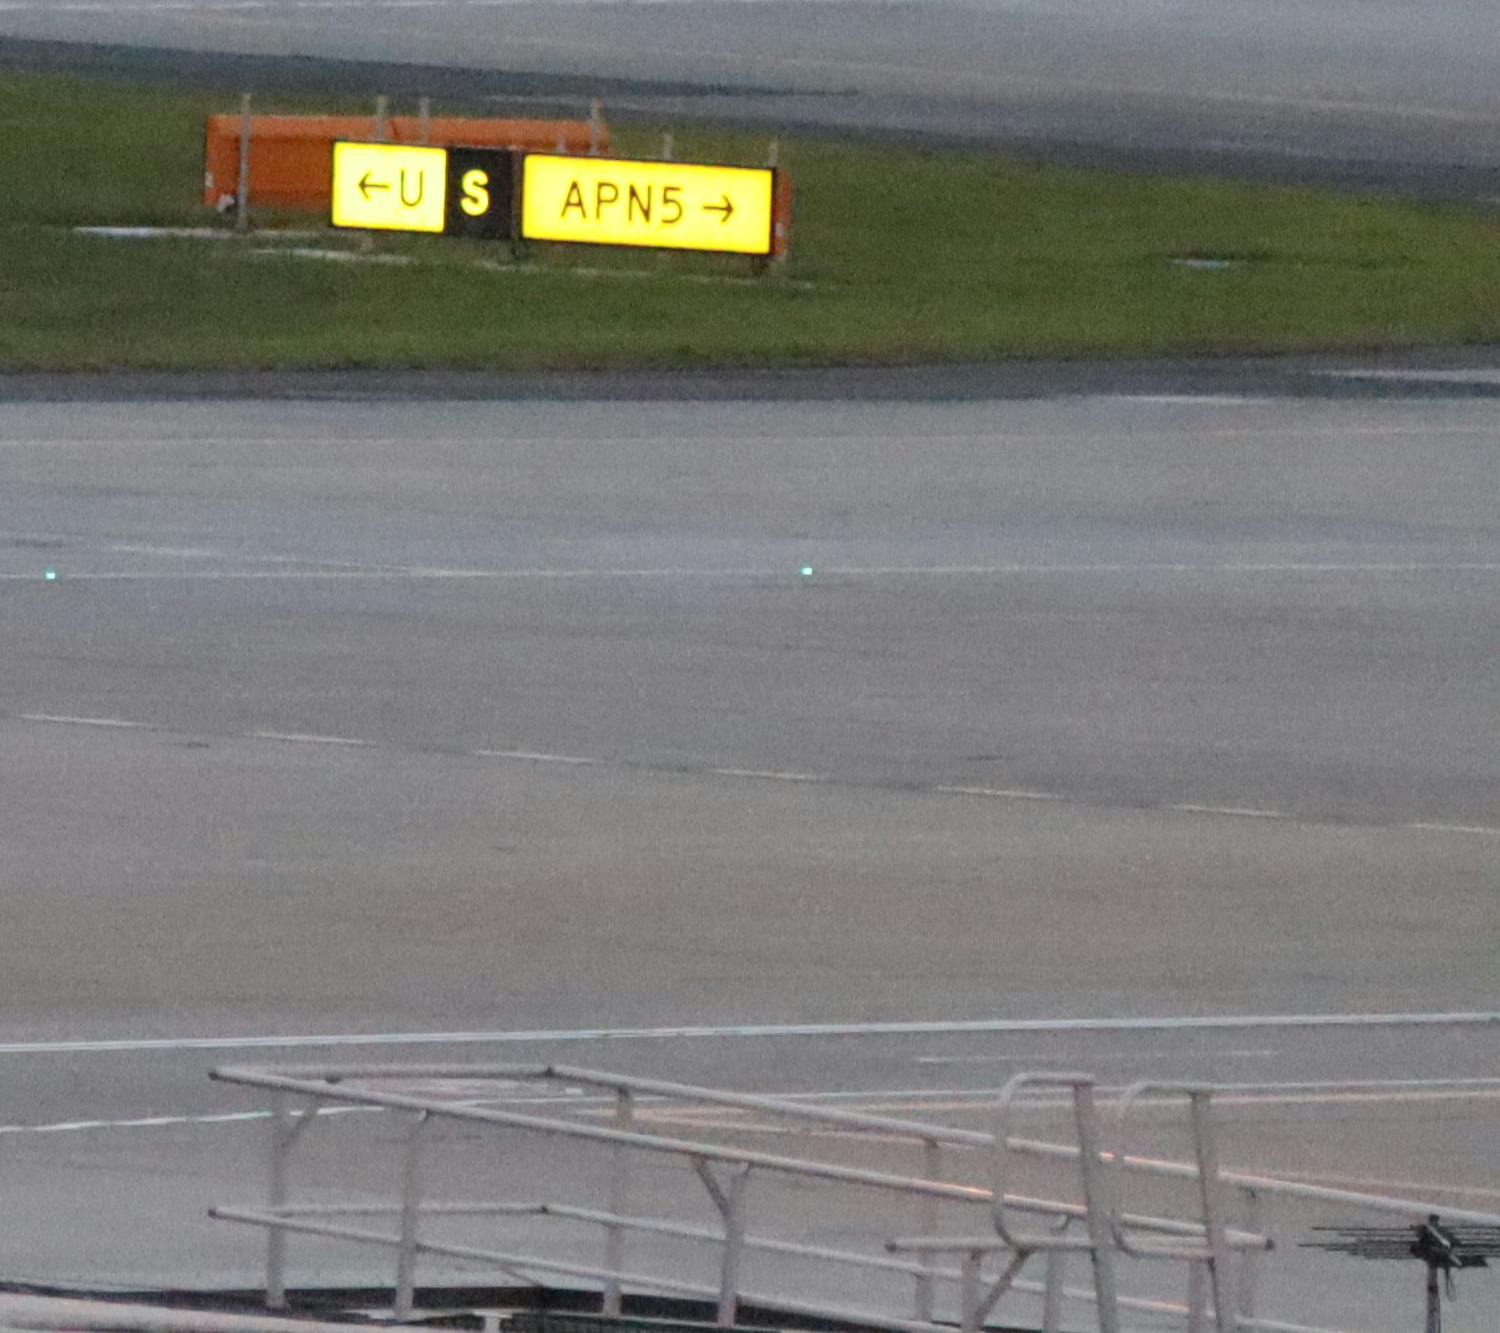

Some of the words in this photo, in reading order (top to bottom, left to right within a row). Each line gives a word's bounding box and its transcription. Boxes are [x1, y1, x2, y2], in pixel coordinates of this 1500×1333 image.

[400, 168, 424, 208] U
[460, 168, 490, 216] S
[560, 180, 684, 225] APN5
